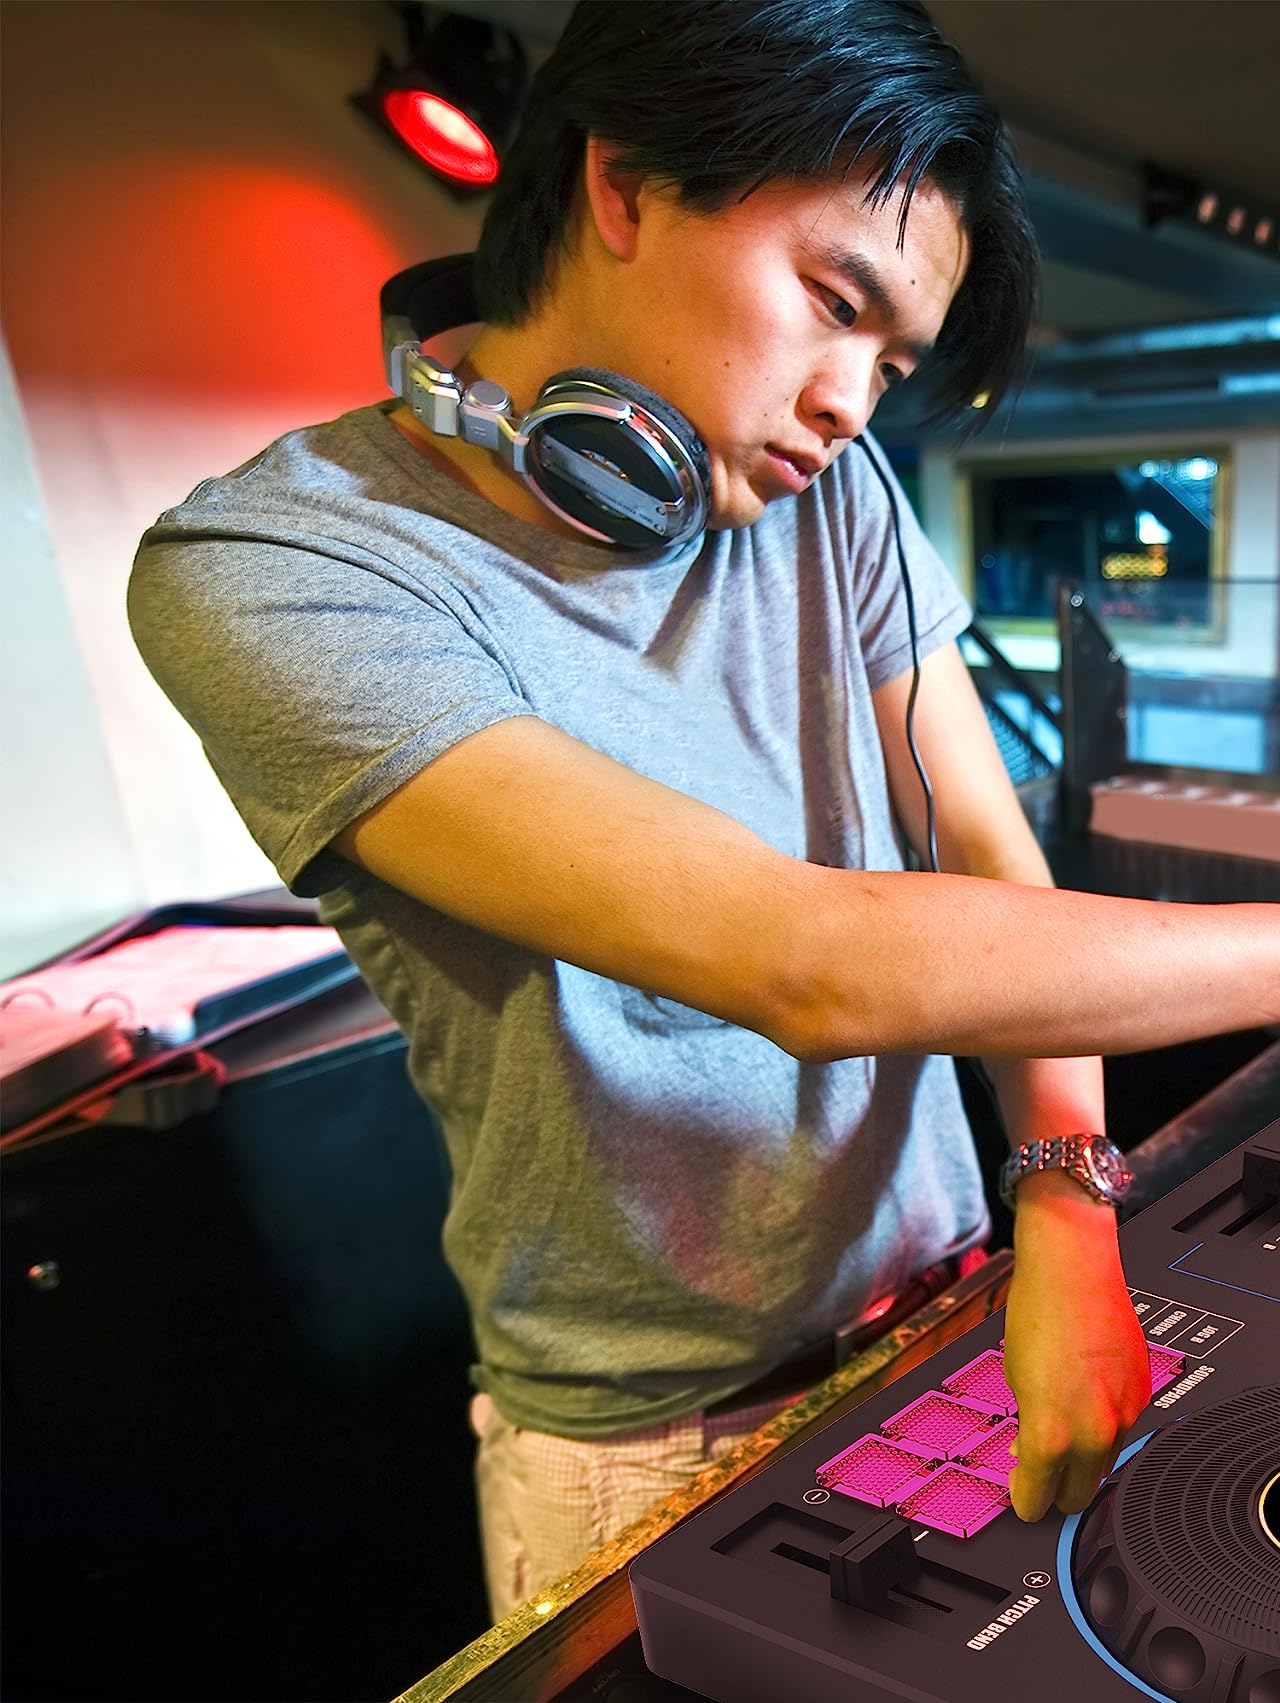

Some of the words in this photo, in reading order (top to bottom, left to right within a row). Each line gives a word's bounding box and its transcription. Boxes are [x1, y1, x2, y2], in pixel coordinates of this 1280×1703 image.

[1149, 1310, 1188, 1337] CHORUS
[1199, 1325, 1220, 1339] JOG
[1190, 1334, 1205, 1344] B
[1153, 1365, 1216, 1409] SOUNDPADS
[996, 1594, 1041, 1626] PITCH
[966, 1622, 1008, 1651] BEND
